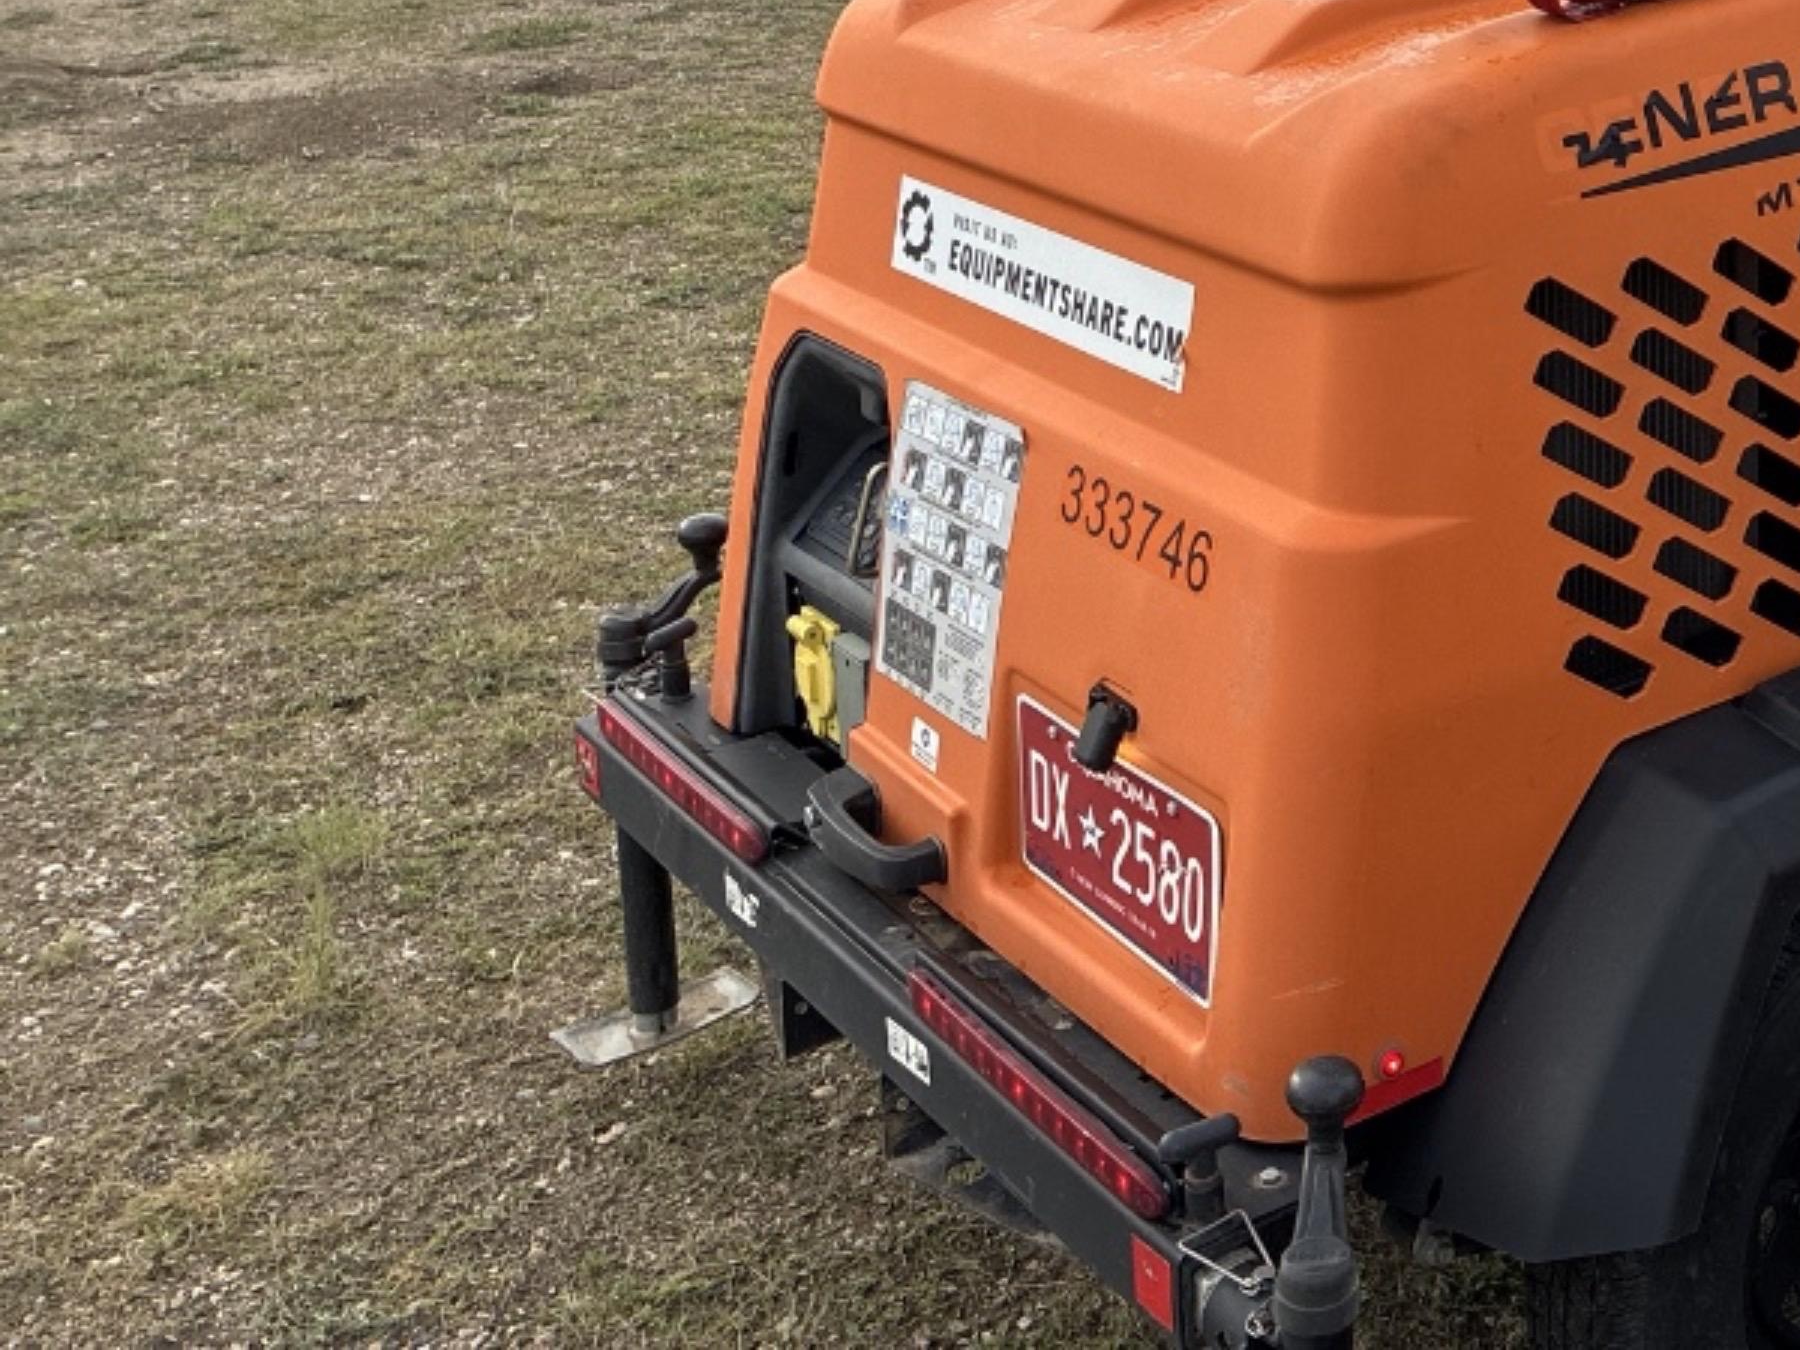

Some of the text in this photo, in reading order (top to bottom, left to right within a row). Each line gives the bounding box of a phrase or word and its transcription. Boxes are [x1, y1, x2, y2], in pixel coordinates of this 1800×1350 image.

[946, 238, 1184, 365] EQUIPMENTSHARE.COM
[1061, 464, 1214, 593] 333746
[1029, 748, 1072, 850] DX
[1109, 808, 1205, 944] 2580
